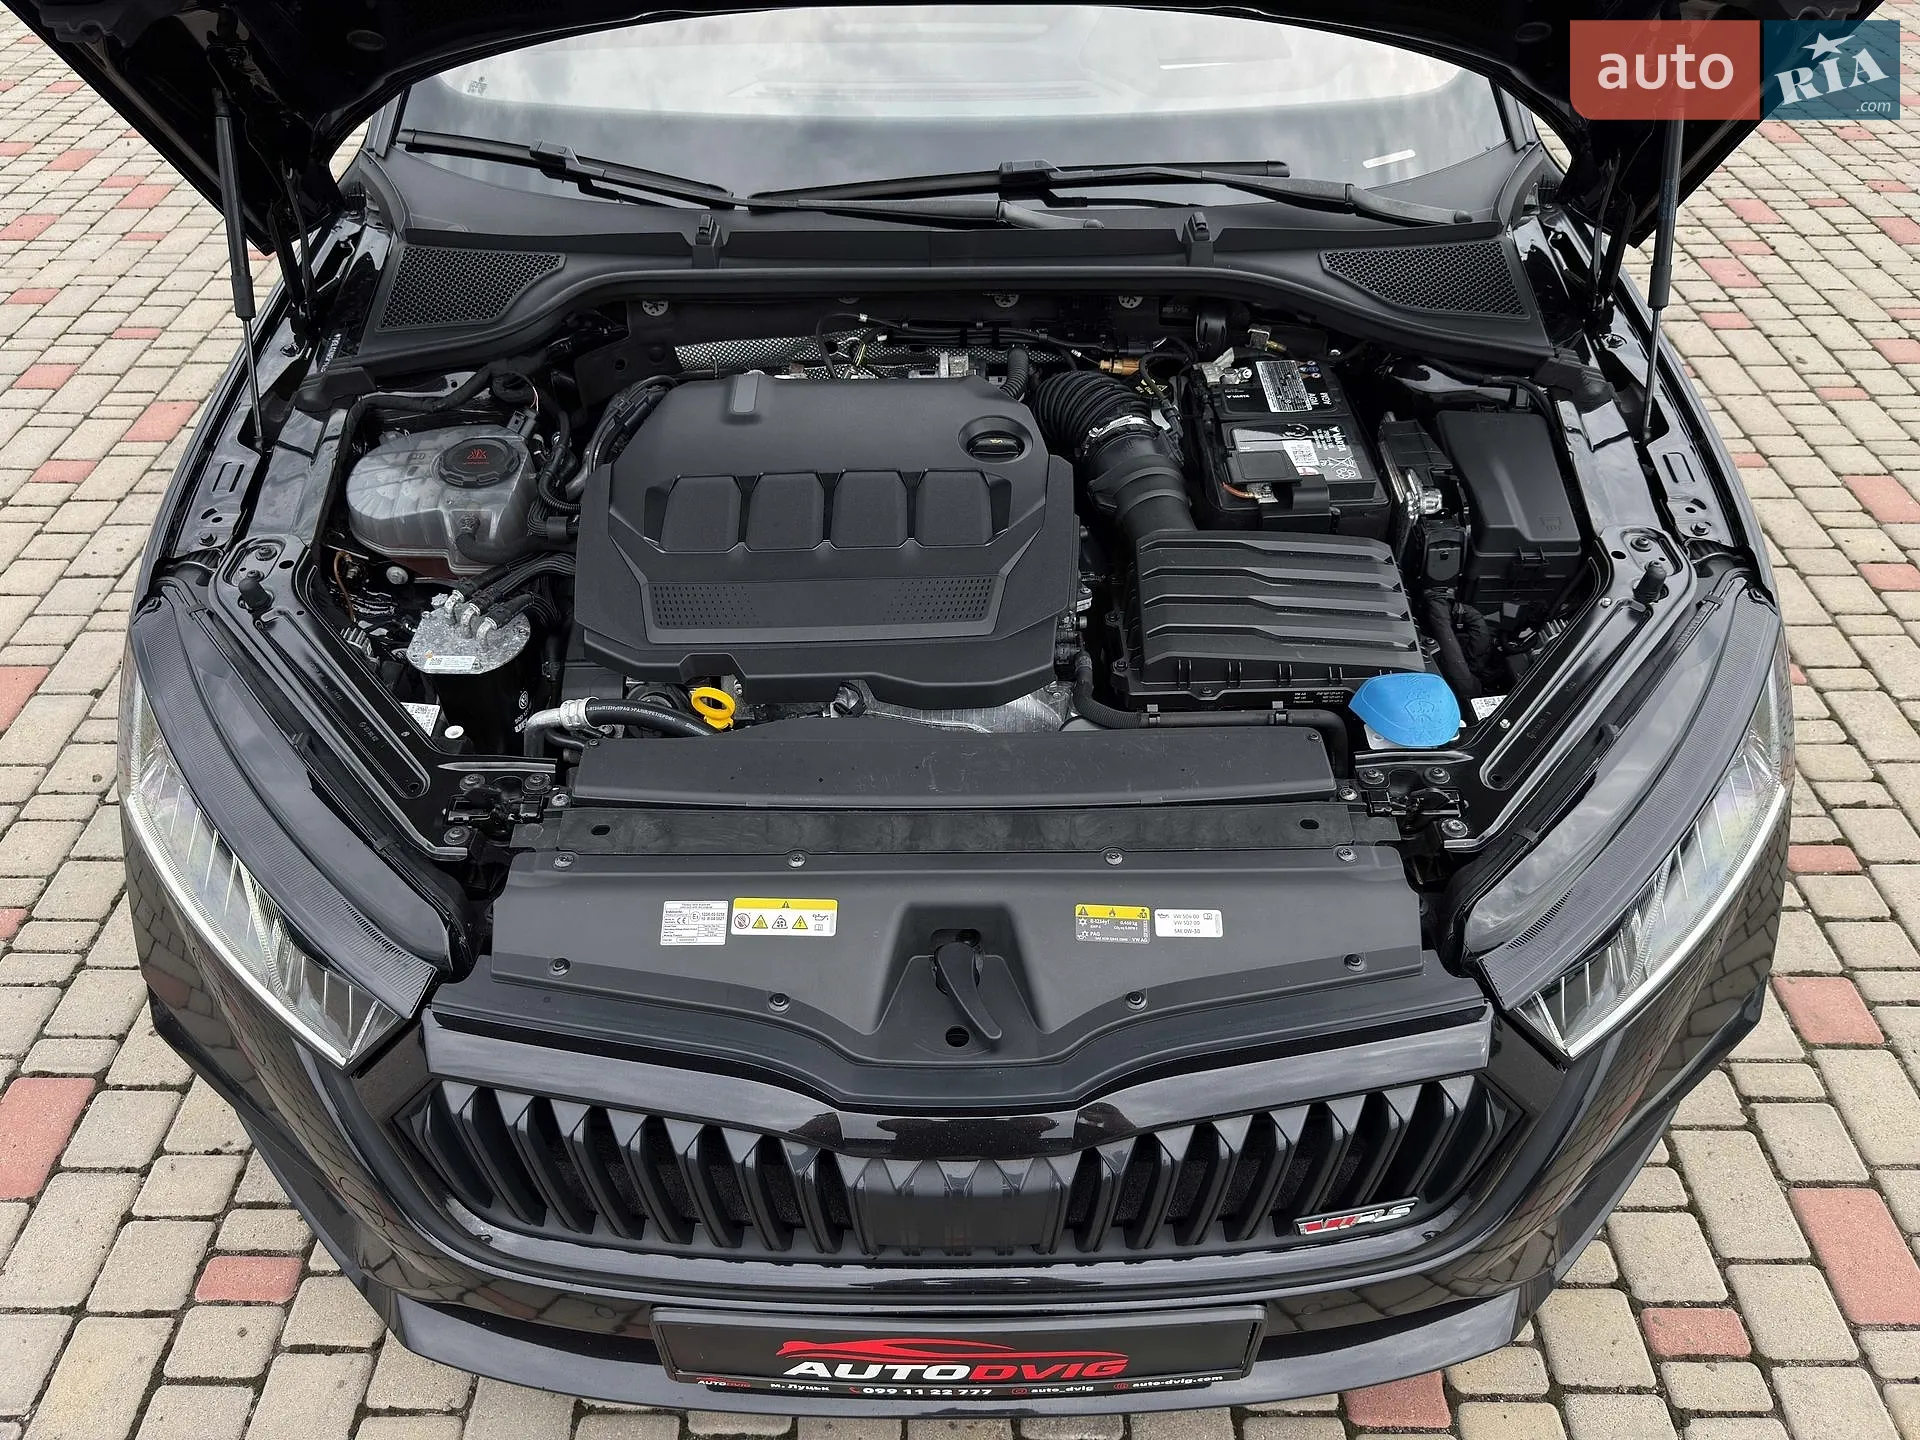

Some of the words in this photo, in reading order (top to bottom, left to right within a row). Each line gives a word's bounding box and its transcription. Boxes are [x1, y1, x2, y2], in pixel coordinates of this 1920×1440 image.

[783, 1358, 1129, 1382] AUTODVIG
[1132, 1374, 1224, 1388] auto-dvig.com
[903, 1387, 924, 1395] 11
[1031, 1385, 1094, 1393] auto_dvig
